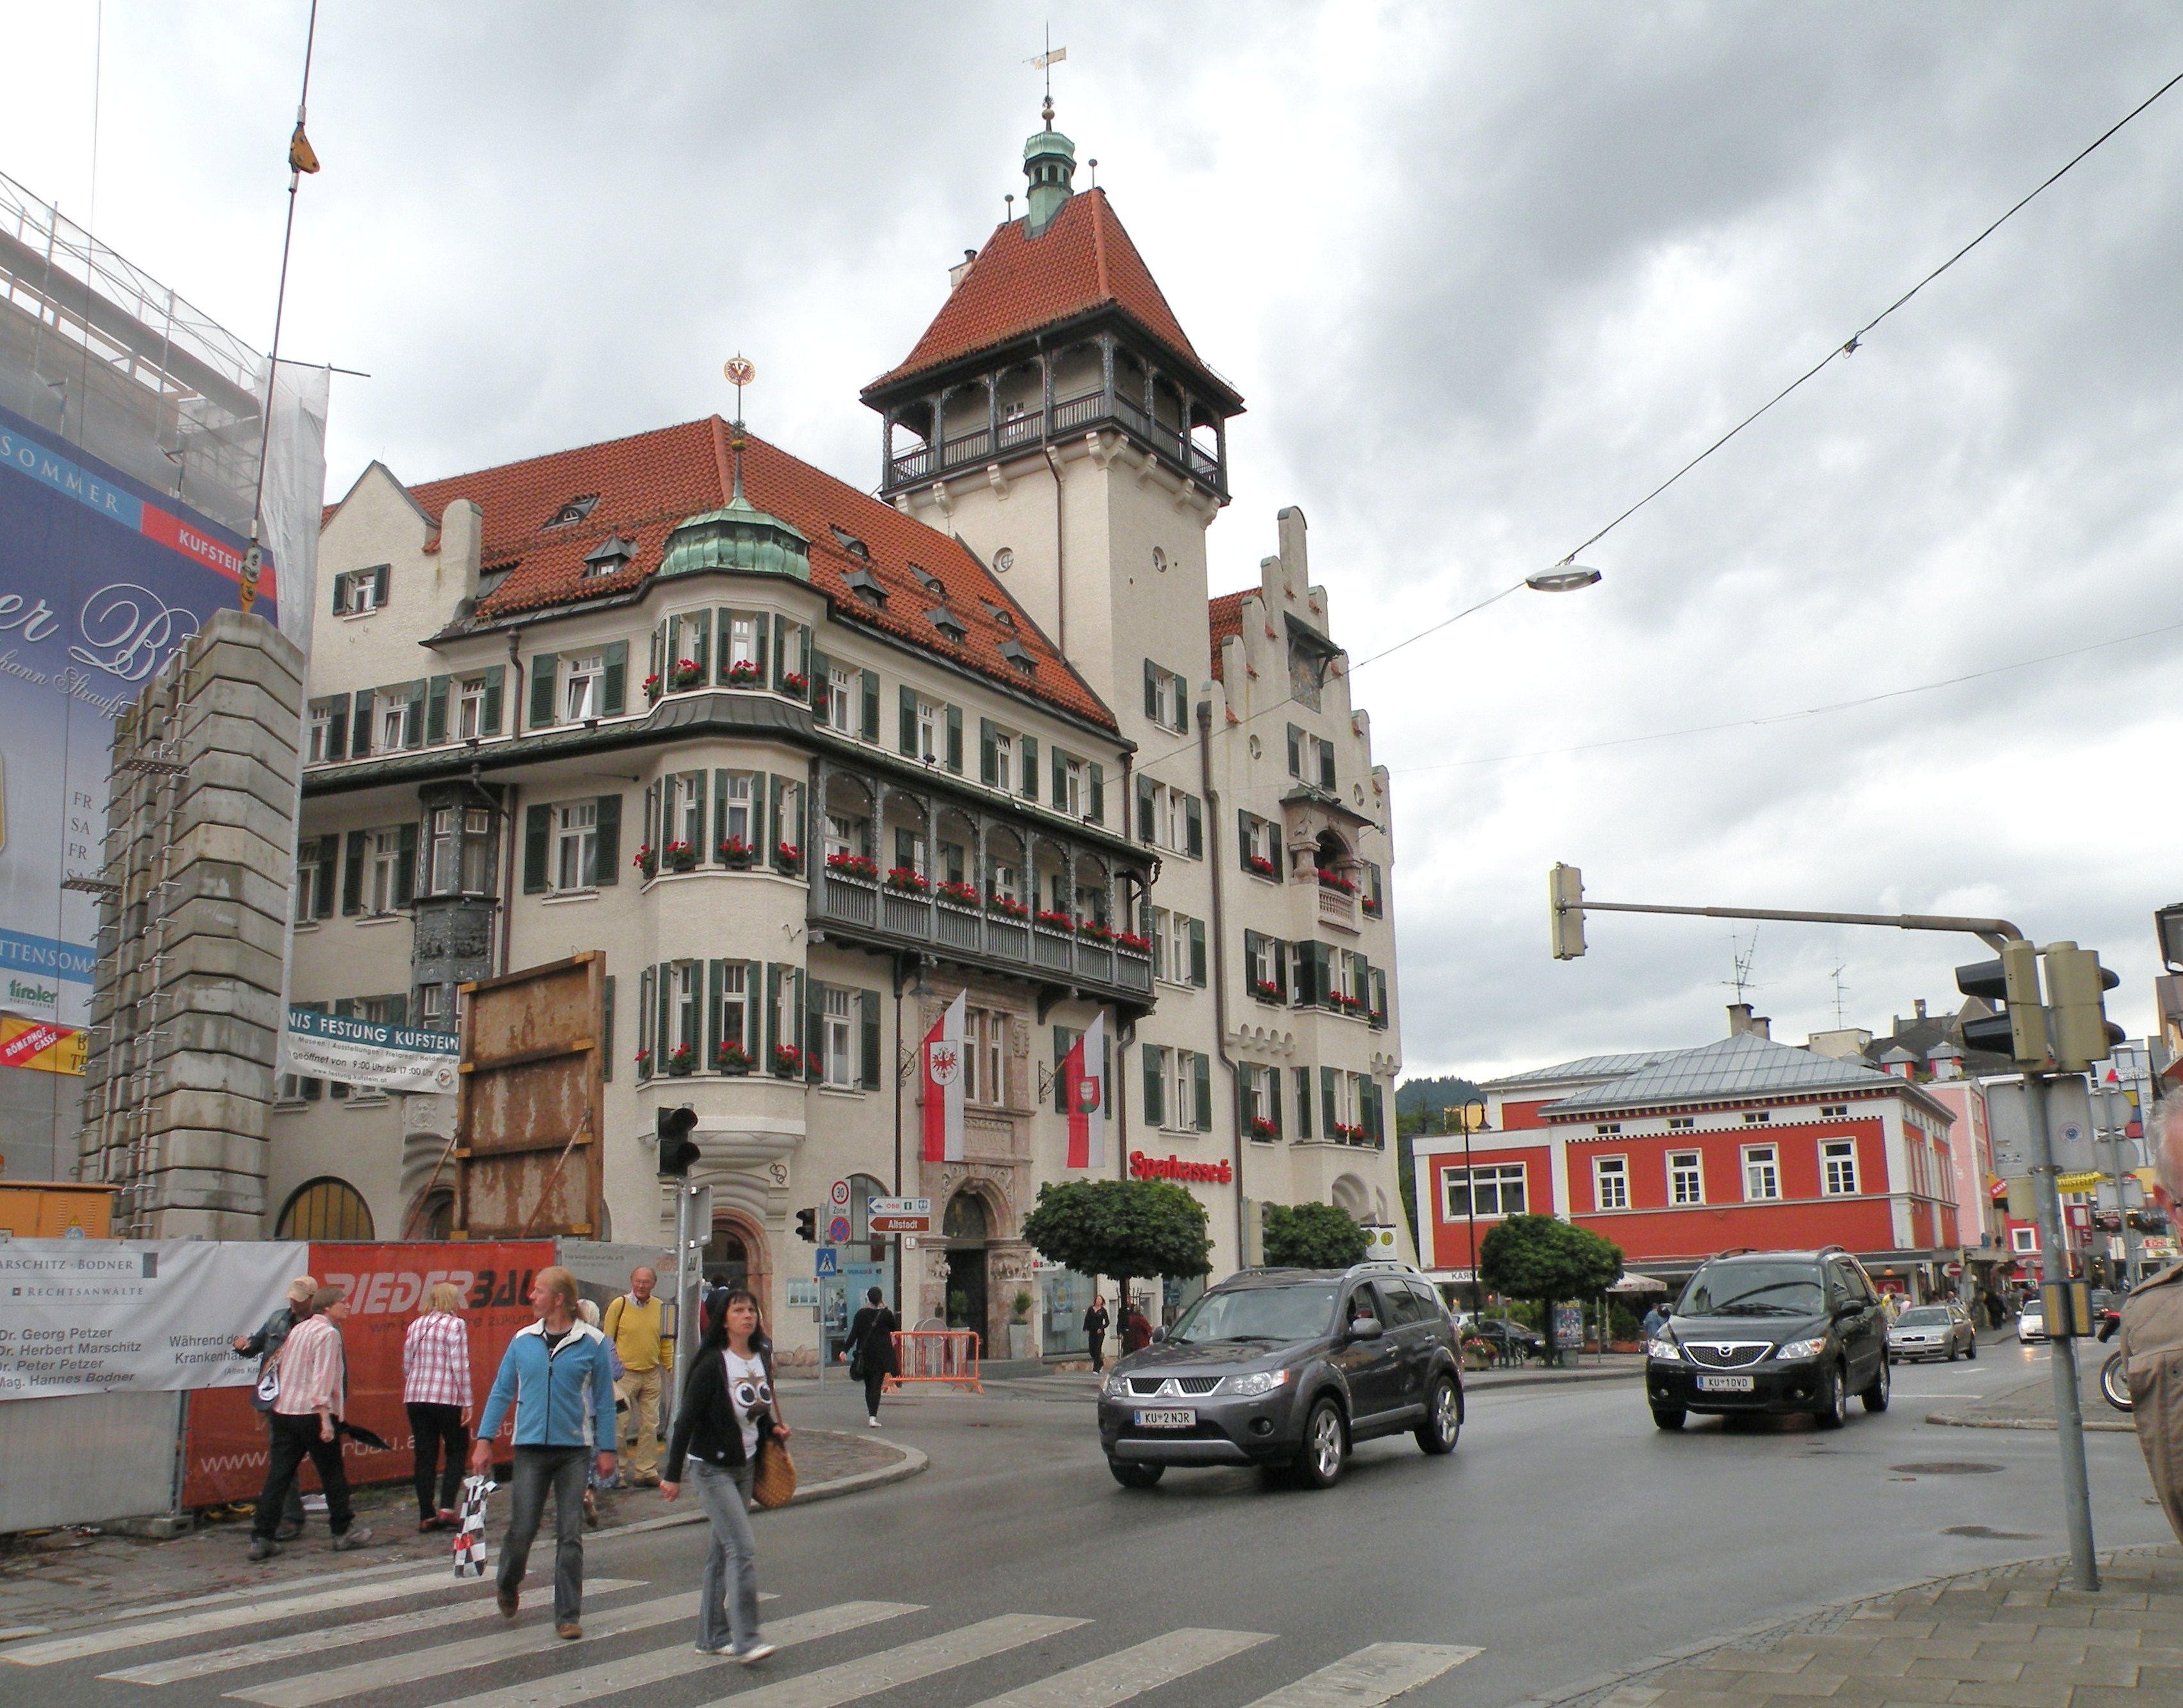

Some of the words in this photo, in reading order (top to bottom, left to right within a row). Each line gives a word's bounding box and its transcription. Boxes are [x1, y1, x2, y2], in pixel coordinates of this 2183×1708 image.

[74, 792, 92, 809] FR
[71, 817, 90, 835] SA
[69, 843, 87, 860] FR
[10, 979, 57, 1004] tiroler
[321, 1017, 387, 1042] FESTUNG
[395, 1030, 460, 1051] KUFSTEIN
[5, 1027, 47, 1057] RÖMERHOF
[34, 1032, 58, 1051] GASSE
[297, 1036, 326, 1047] Museen
[293, 1051, 330, 1064] geöffnet
[331, 1057, 347, 1066] von
[372, 1063, 385, 1072] Uhr
[385, 1065, 396, 1073] bis
[422, 1068, 434, 1077] Uhr
[1130, 1150, 1219, 1182] Sparkasse
[837, 1187, 844, 1198] 30
[888, 1219, 918, 1229] Altstadt
[78, 1259, 133, 1270] BODNER
[22, 1329, 65, 1341] Georg
[70, 1328, 112, 1339] Petzer
[169, 1334, 224, 1346] Während
[20, 1344, 73, 1356] Herbert
[78, 1342, 141, 1354] Marschitz
[17, 1361, 55, 1371] Peter
[60, 1359, 104, 1369] Petzer
[29, 1374, 81, 1386] Hannes
[86, 1373, 135, 1382] Bodner
[1145, 1412, 1157, 1423] KU
